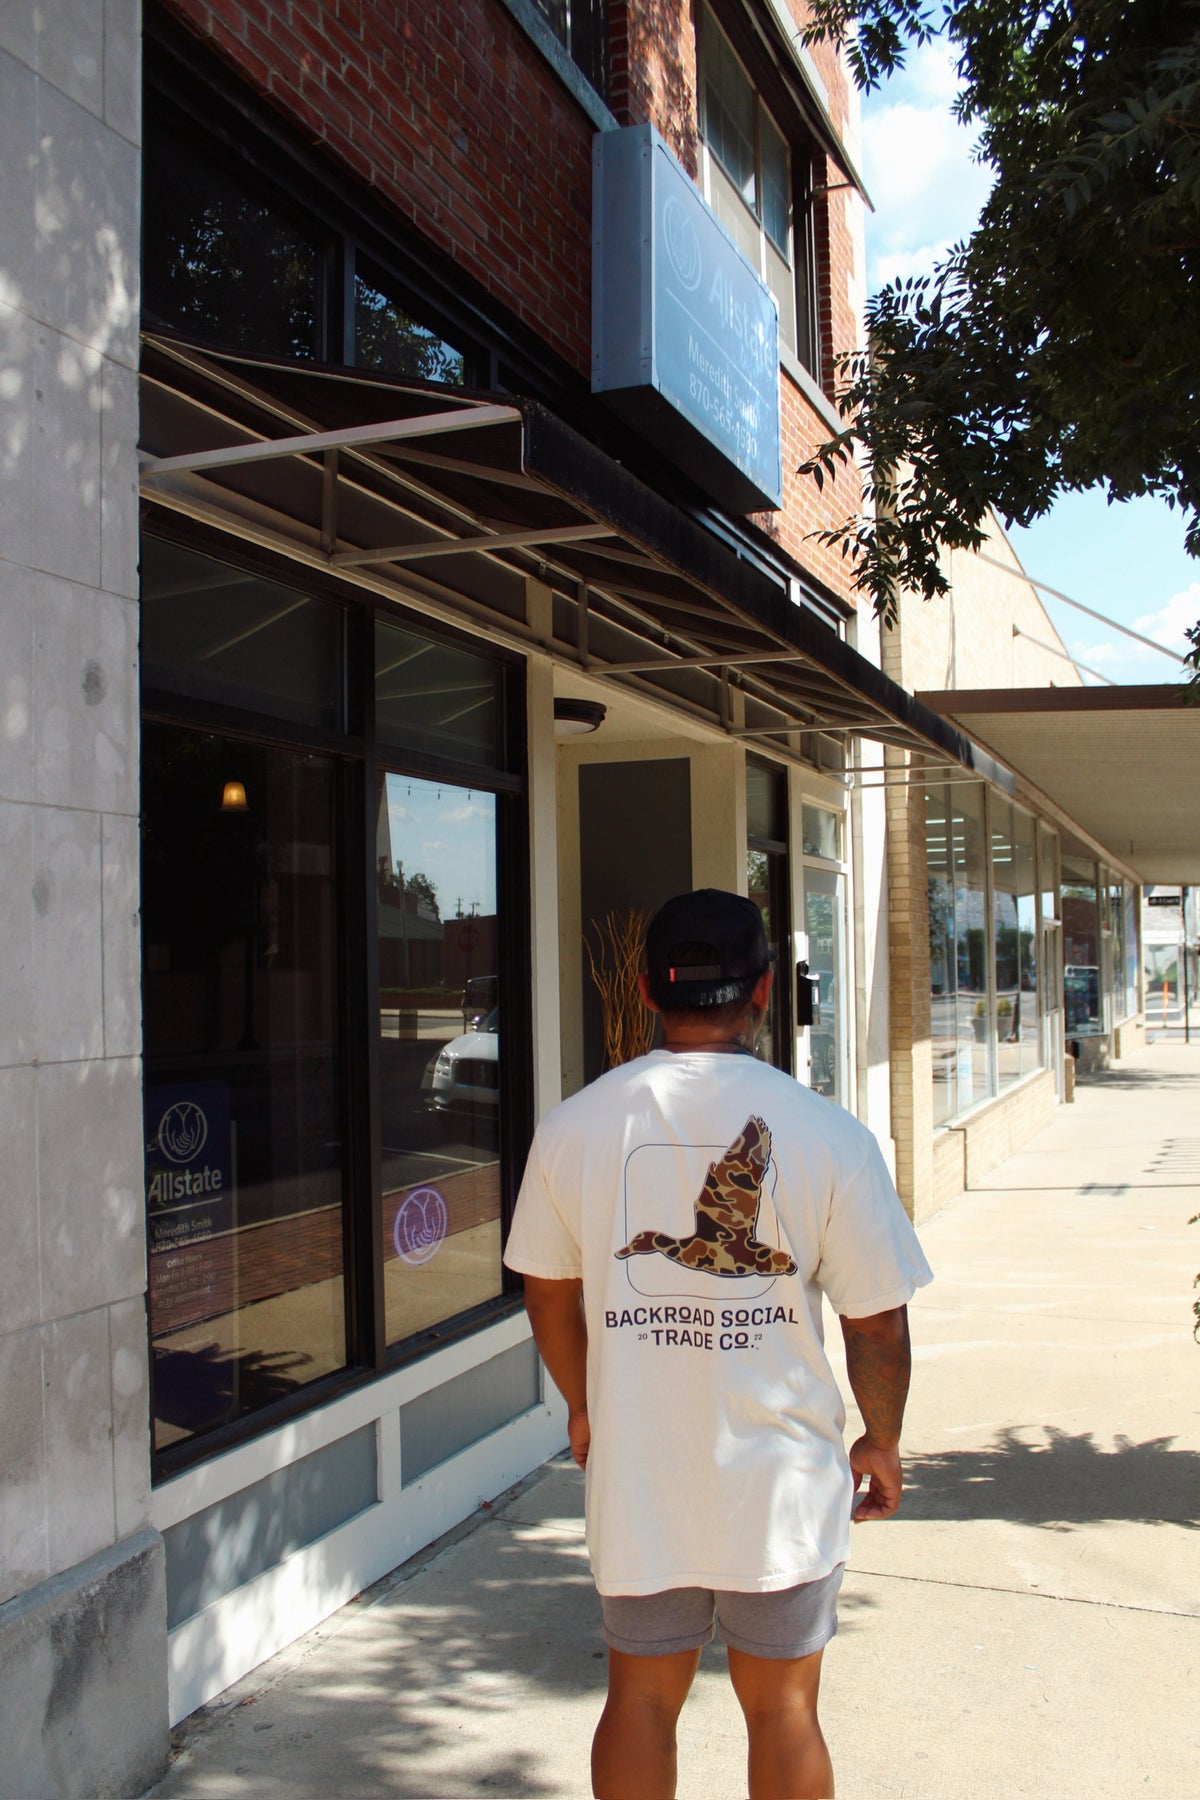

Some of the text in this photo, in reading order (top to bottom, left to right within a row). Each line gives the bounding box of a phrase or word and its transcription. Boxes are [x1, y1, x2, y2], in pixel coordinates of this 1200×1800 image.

[709, 266, 775, 378] Allstate
[689, 335, 758, 431] Meredith Smith
[690, 372, 758, 459] 870-565-4580
[148, 1165, 222, 1203] Allstate
[155, 1217, 212, 1239] Meredith Smith
[167, 1256, 185, 1268] Office
[605, 1306, 799, 1328] BACKROAD SOCIAL
[637, 1329, 763, 1351] 20 TRADE CO. 22
